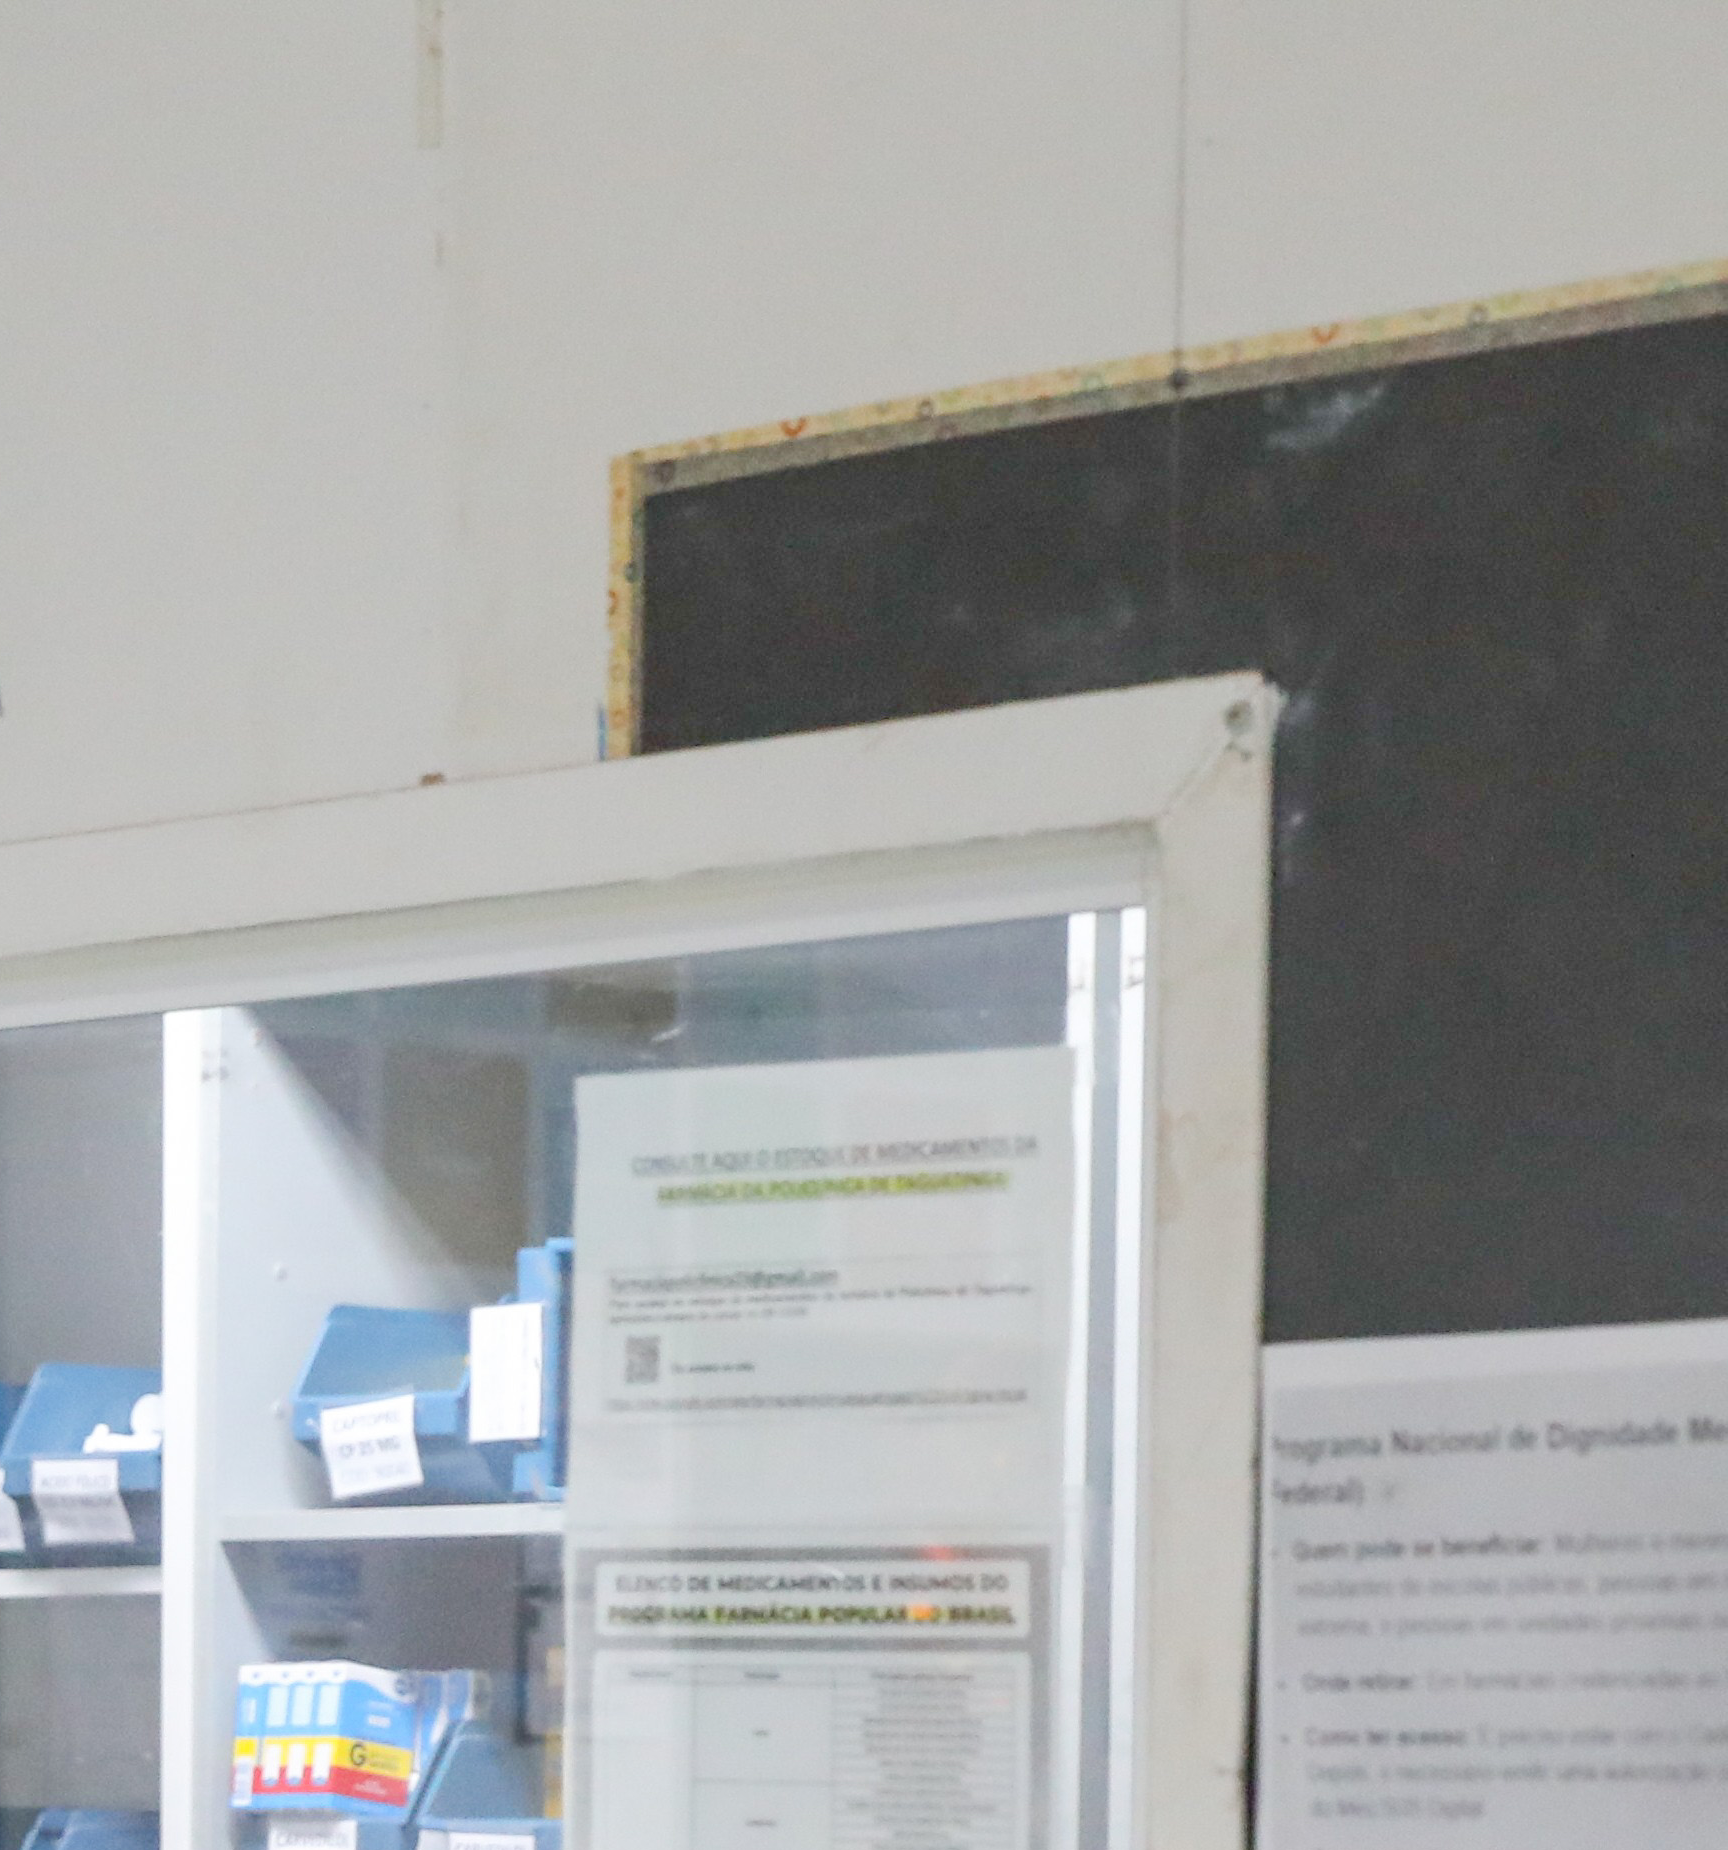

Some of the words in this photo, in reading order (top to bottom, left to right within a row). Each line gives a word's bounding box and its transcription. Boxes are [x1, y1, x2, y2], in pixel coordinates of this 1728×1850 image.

[687, 1573, 711, 1594] DE
[717, 1573, 866, 1594] MEDICAMENTOS
[871, 1573, 883, 1593] E
[889, 1573, 976, 1593] INSUMOS
[980, 1573, 1010, 1592] DO
[608, 1603, 710, 1625] PROGRAMA
[714, 1601, 812, 1625] FARMÁCIA
[349, 1742, 368, 1767] G
